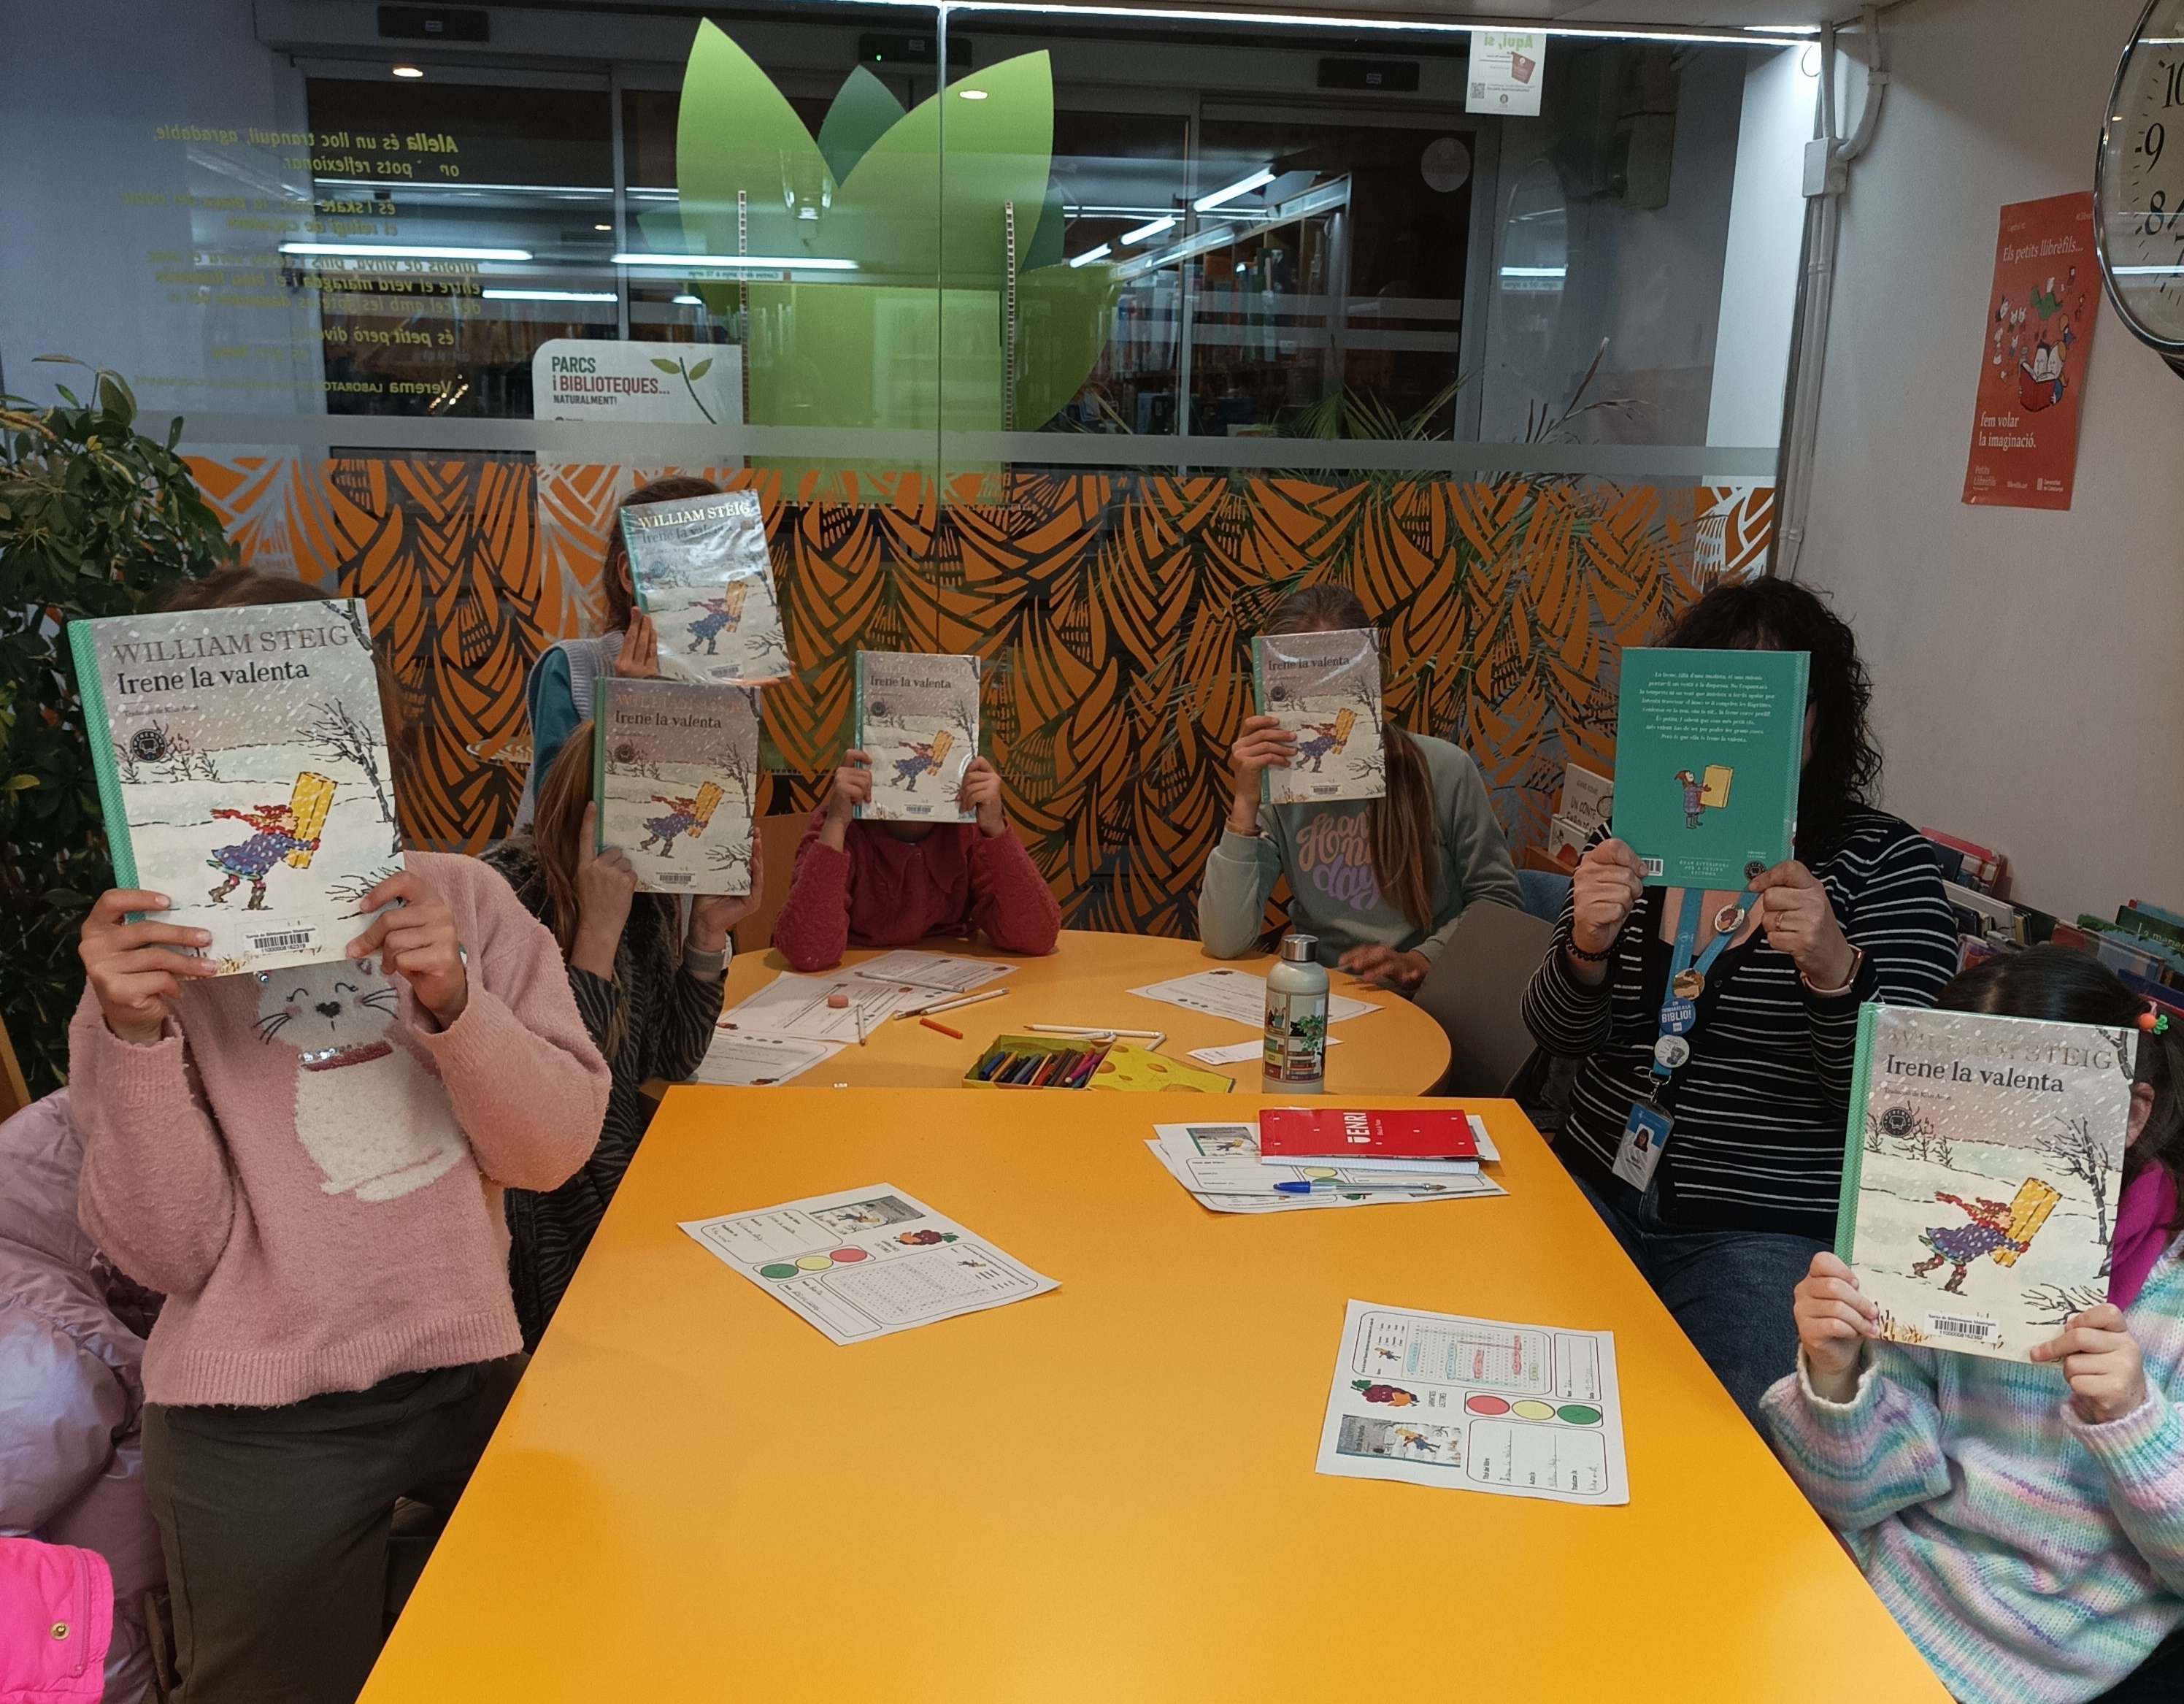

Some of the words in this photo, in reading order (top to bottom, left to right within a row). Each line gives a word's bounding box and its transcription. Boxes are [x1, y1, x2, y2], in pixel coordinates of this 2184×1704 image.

[2145, 122, 2165, 173] 9
[2145, 191, 2166, 235] 8
[2003, 245, 2014, 261] Els
[2015, 243, 2038, 264] petits
[552, 356, 596, 373] PARCS
[553, 377, 557, 391] i
[560, 377, 670, 396] BIBLIOTEQUES...
[553, 394, 617, 405] NATURALMENT!
[1980, 411, 1995, 428] fem
[1998, 411, 2020, 429] volar
[1979, 431, 1986, 447] la
[1988, 432, 2037, 451] imaginació.
[638, 509, 705, 529] WILLIAM
[707, 500, 752, 519] STEIG
[642, 531, 674, 544] Irene
[677, 527, 688, 539] la
[112, 634, 252, 664] WILLIAM
[260, 625, 350, 652] STEIG
[1298, 658, 1309, 669] la
[1312, 656, 1350, 667] valenta
[118, 672, 185, 695] Irene
[191, 666, 214, 688] la
[220, 661, 309, 685] valenta
[870, 675, 898, 686] Irene
[901, 676, 911, 687] la
[914, 678, 952, 688] valenta
[615, 710, 652, 724] Irene
[655, 713, 668, 726] la
[672, 714, 722, 729] valenta
[1662, 1010, 1691, 1023] BIBLIO!
[2025, 1044, 2112, 1070] STEIG
[1886, 1054, 1945, 1079] Irene
[1951, 1062, 1972, 1083] la
[1980, 1067, 2064, 1092] valenta
